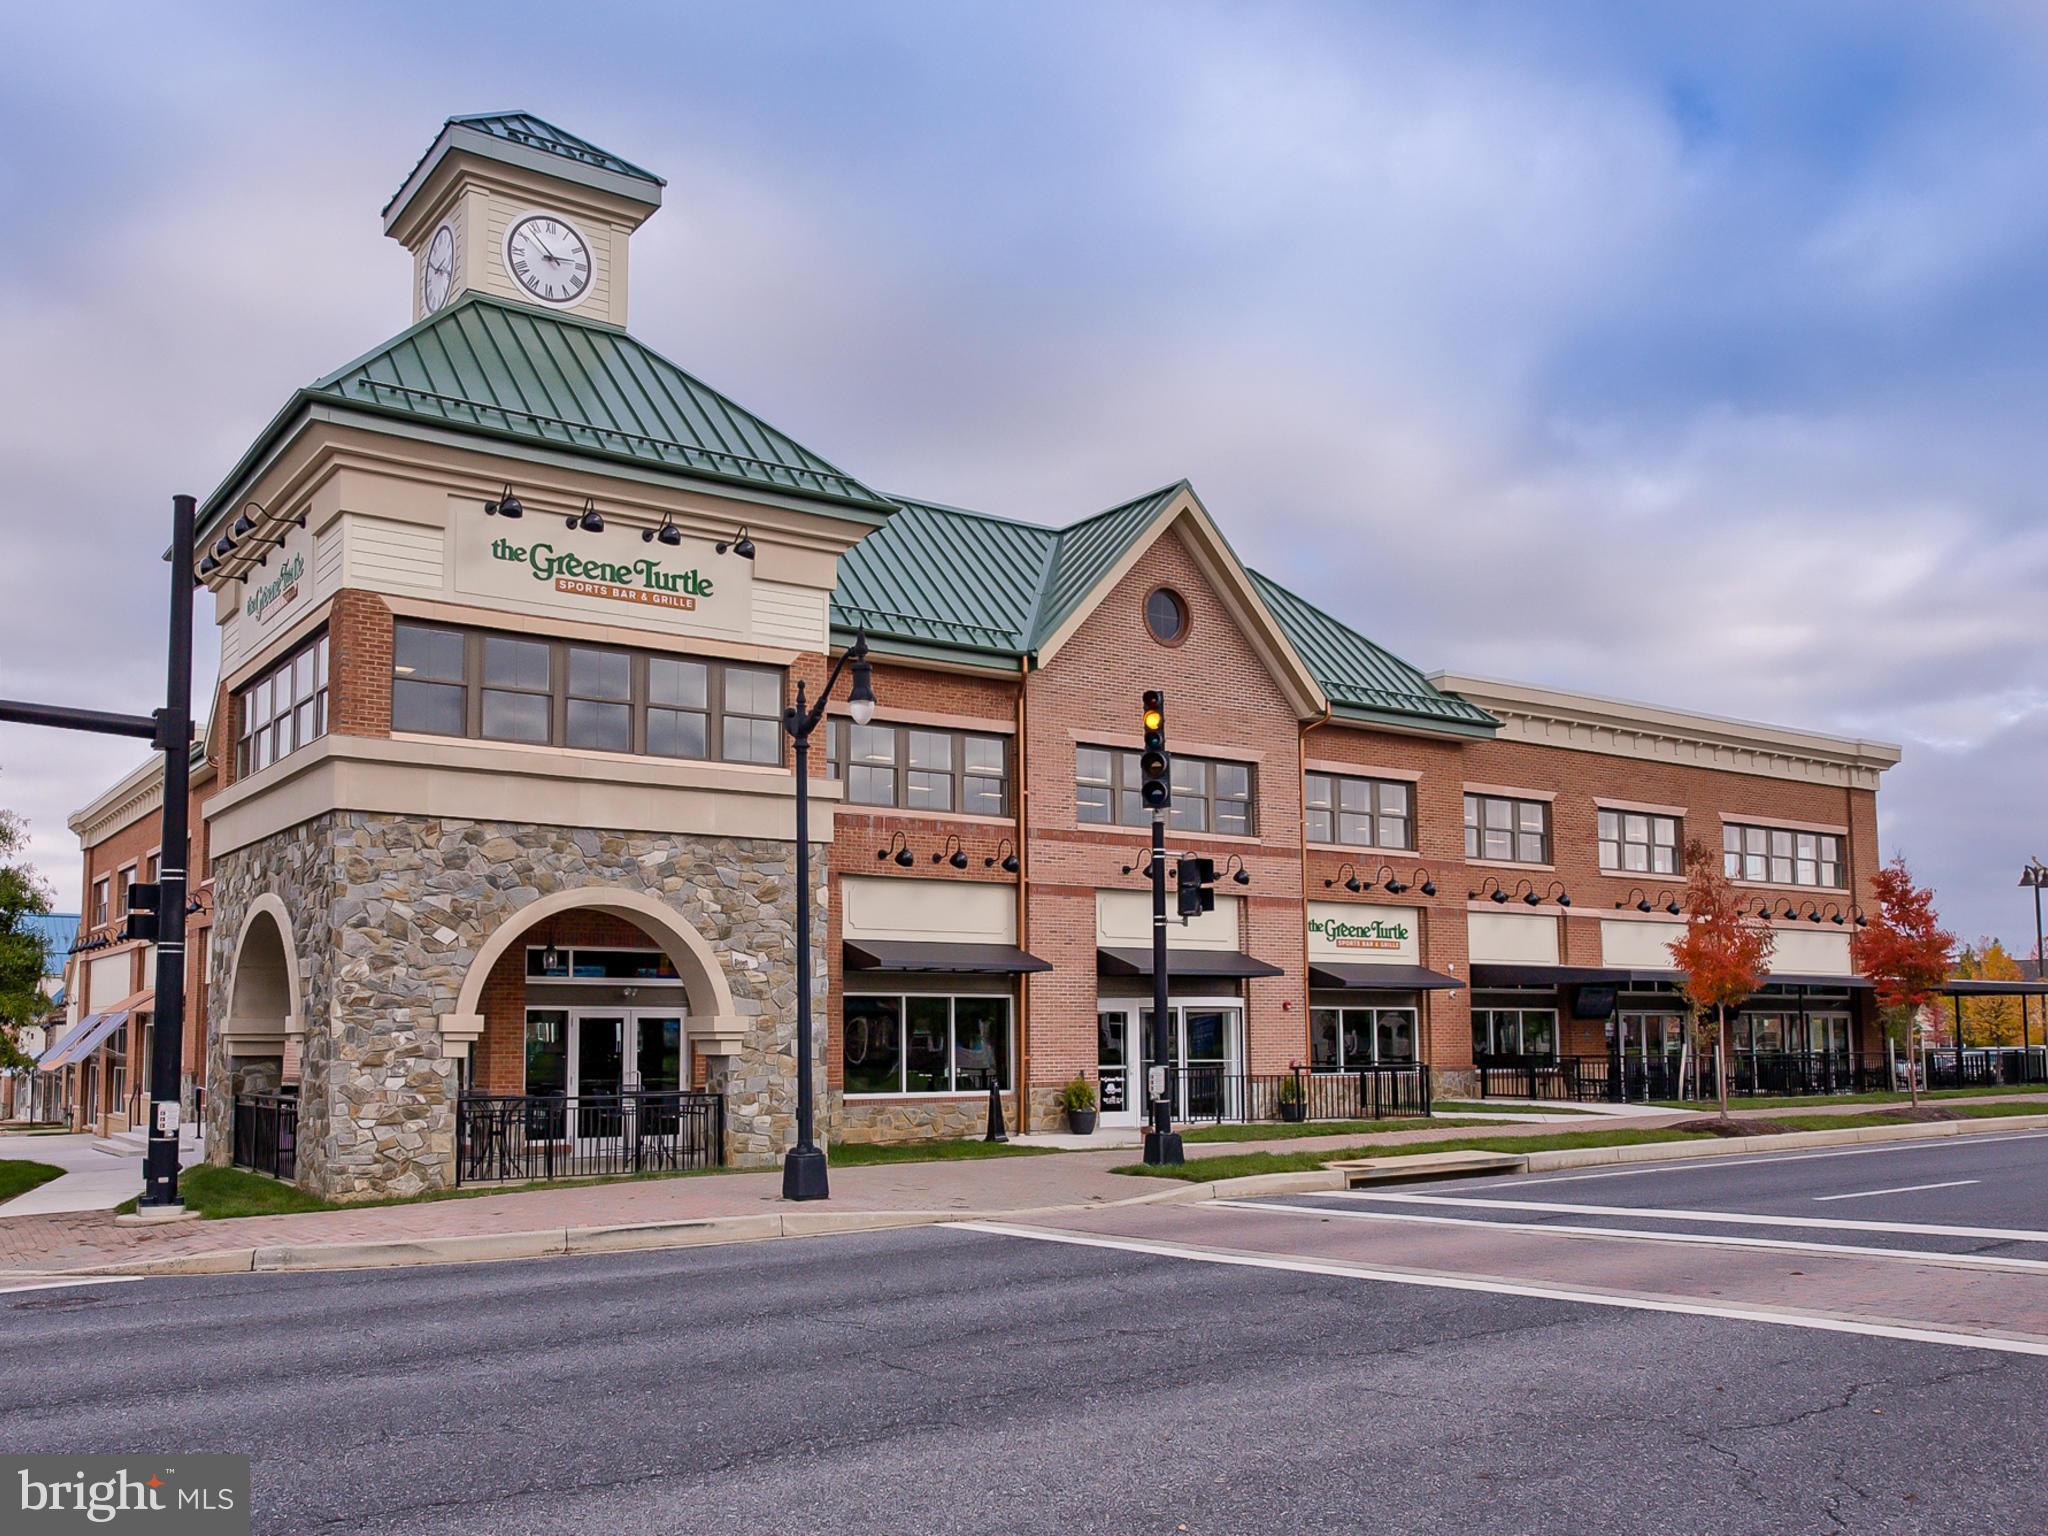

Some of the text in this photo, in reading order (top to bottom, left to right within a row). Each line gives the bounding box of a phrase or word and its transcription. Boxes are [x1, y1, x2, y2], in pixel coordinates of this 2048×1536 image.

[546, 221, 556, 235] XII
[491, 538, 714, 598] the Greene Turtle
[559, 580, 693, 608] SPORTS BAR & GRILLE
[1308, 918, 1409, 942] the Greene Turtle
